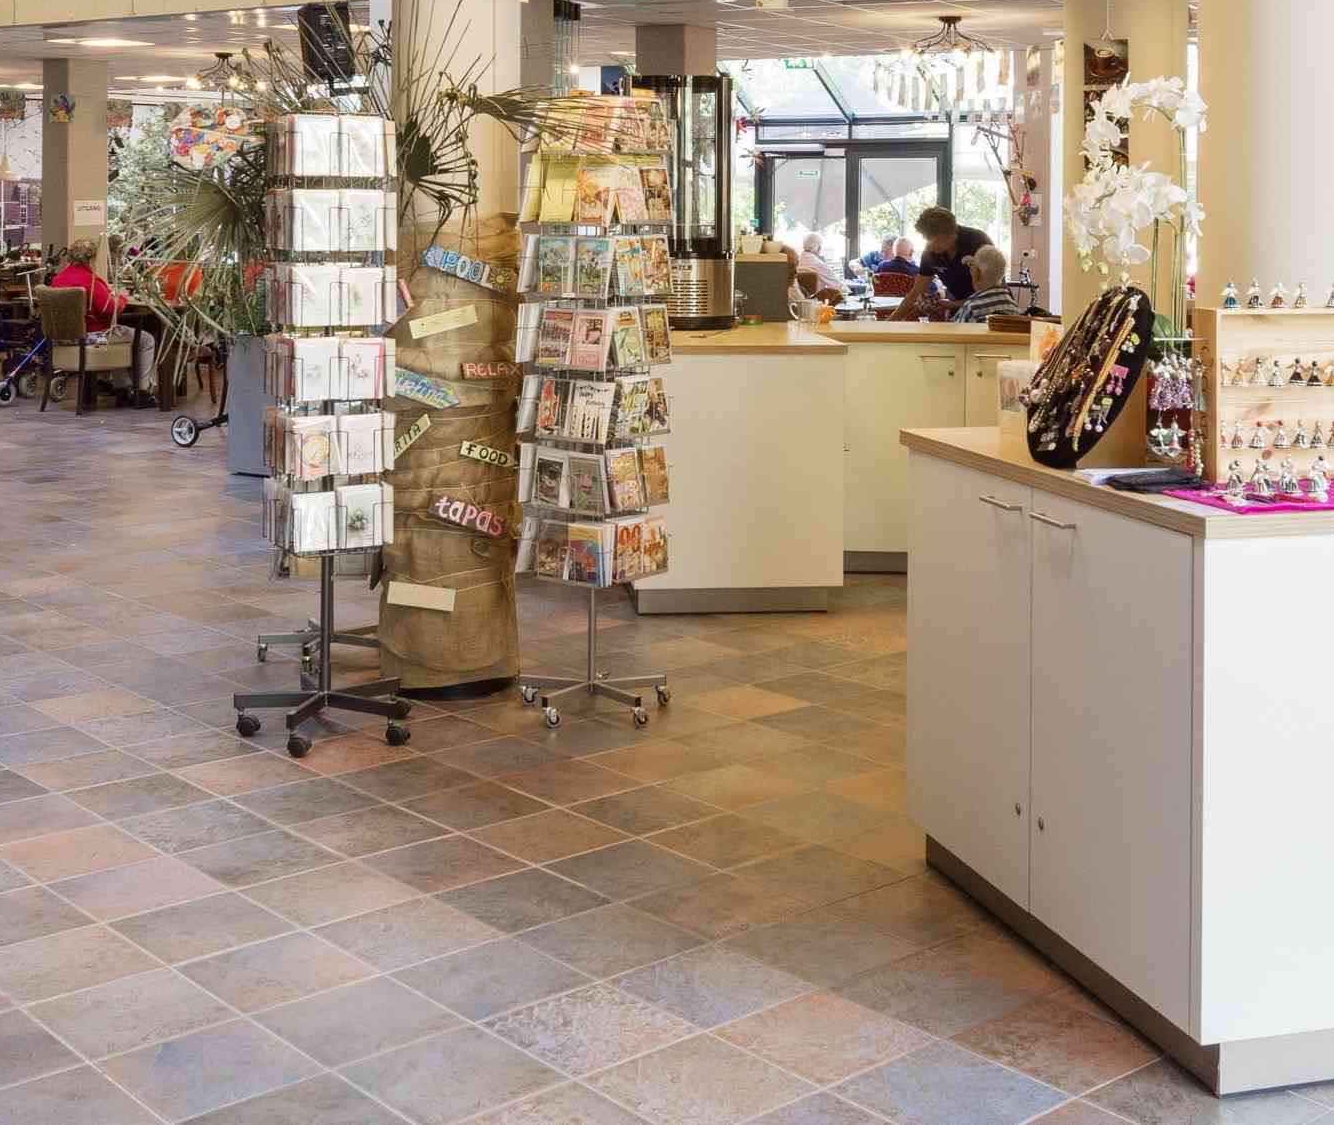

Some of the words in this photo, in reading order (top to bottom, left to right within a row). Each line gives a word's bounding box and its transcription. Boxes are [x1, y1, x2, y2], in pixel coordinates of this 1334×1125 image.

[444, 251, 493, 288] POOL
[466, 362, 518, 376] RELAX
[466, 444, 508, 465] FOOD
[434, 495, 504, 536] tapas
